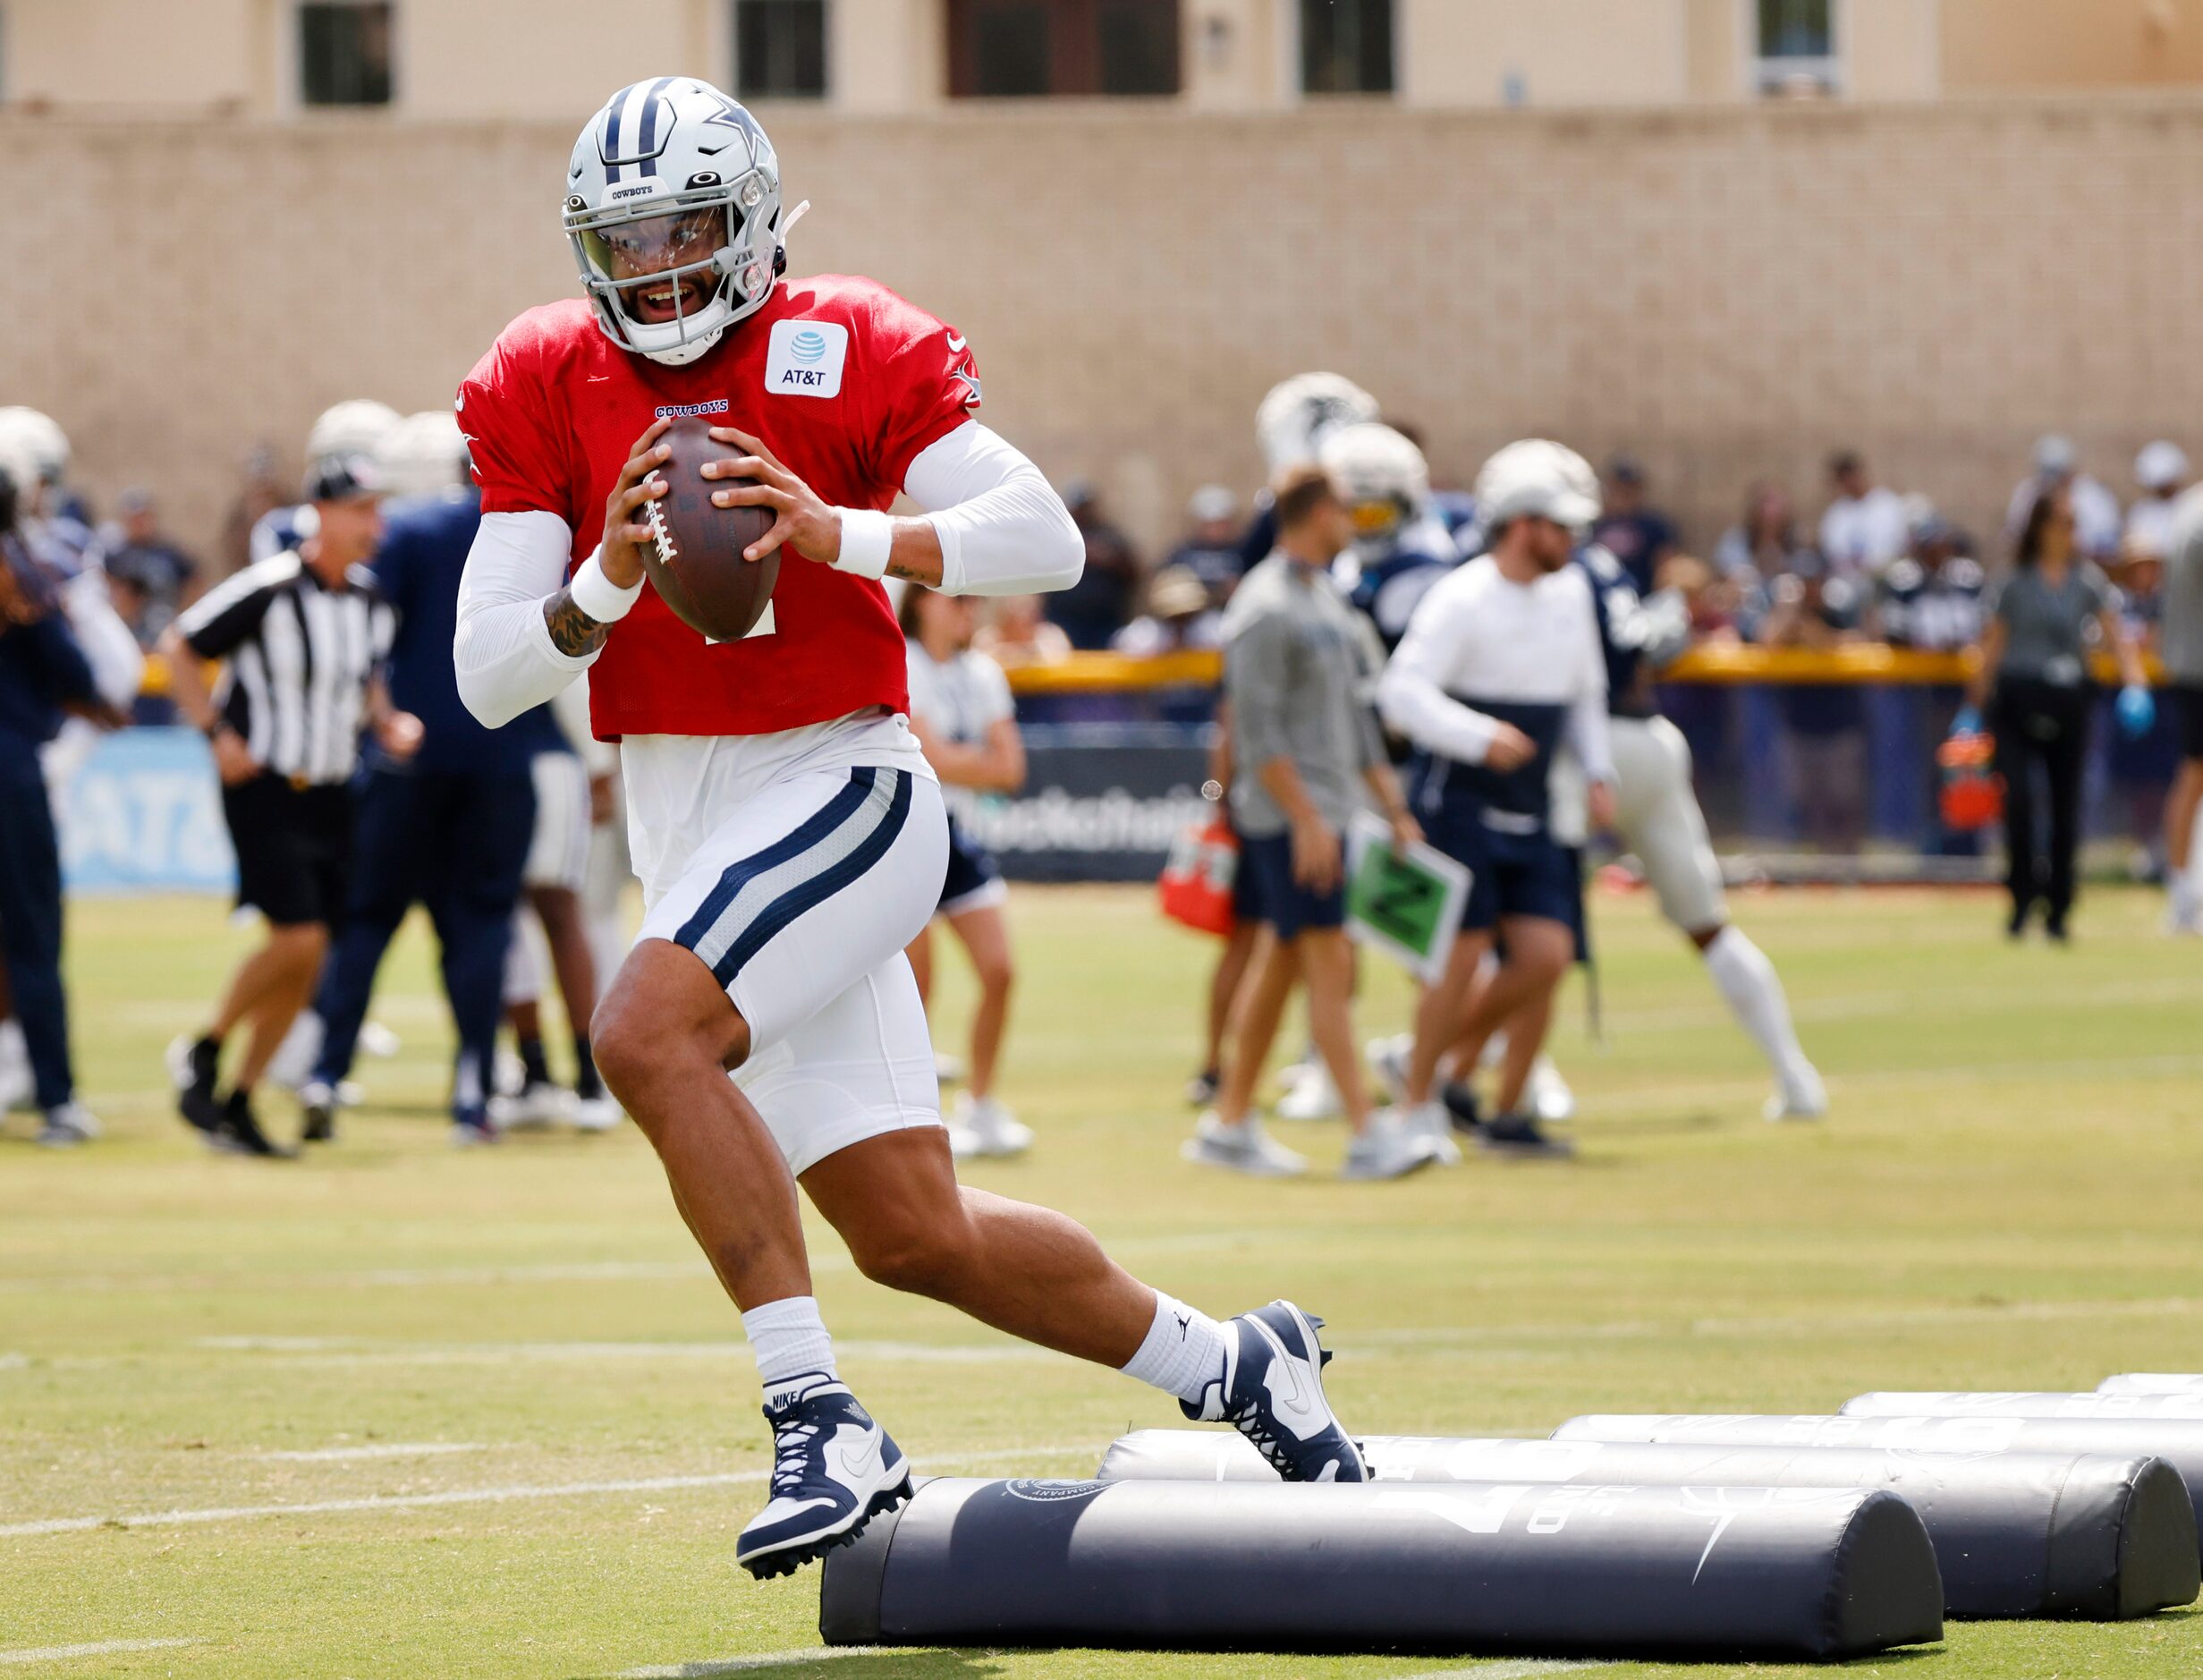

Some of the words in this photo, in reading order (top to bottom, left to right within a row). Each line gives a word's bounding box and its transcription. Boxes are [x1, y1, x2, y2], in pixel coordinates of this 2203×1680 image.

[612, 185, 653, 200] COWBOYS
[782, 369, 826, 386] AT&T
[655, 399, 729, 419] COWBOYS
[773, 1390, 798, 1411] NIKE
[1031, 1485, 1096, 1497] COMPANY
